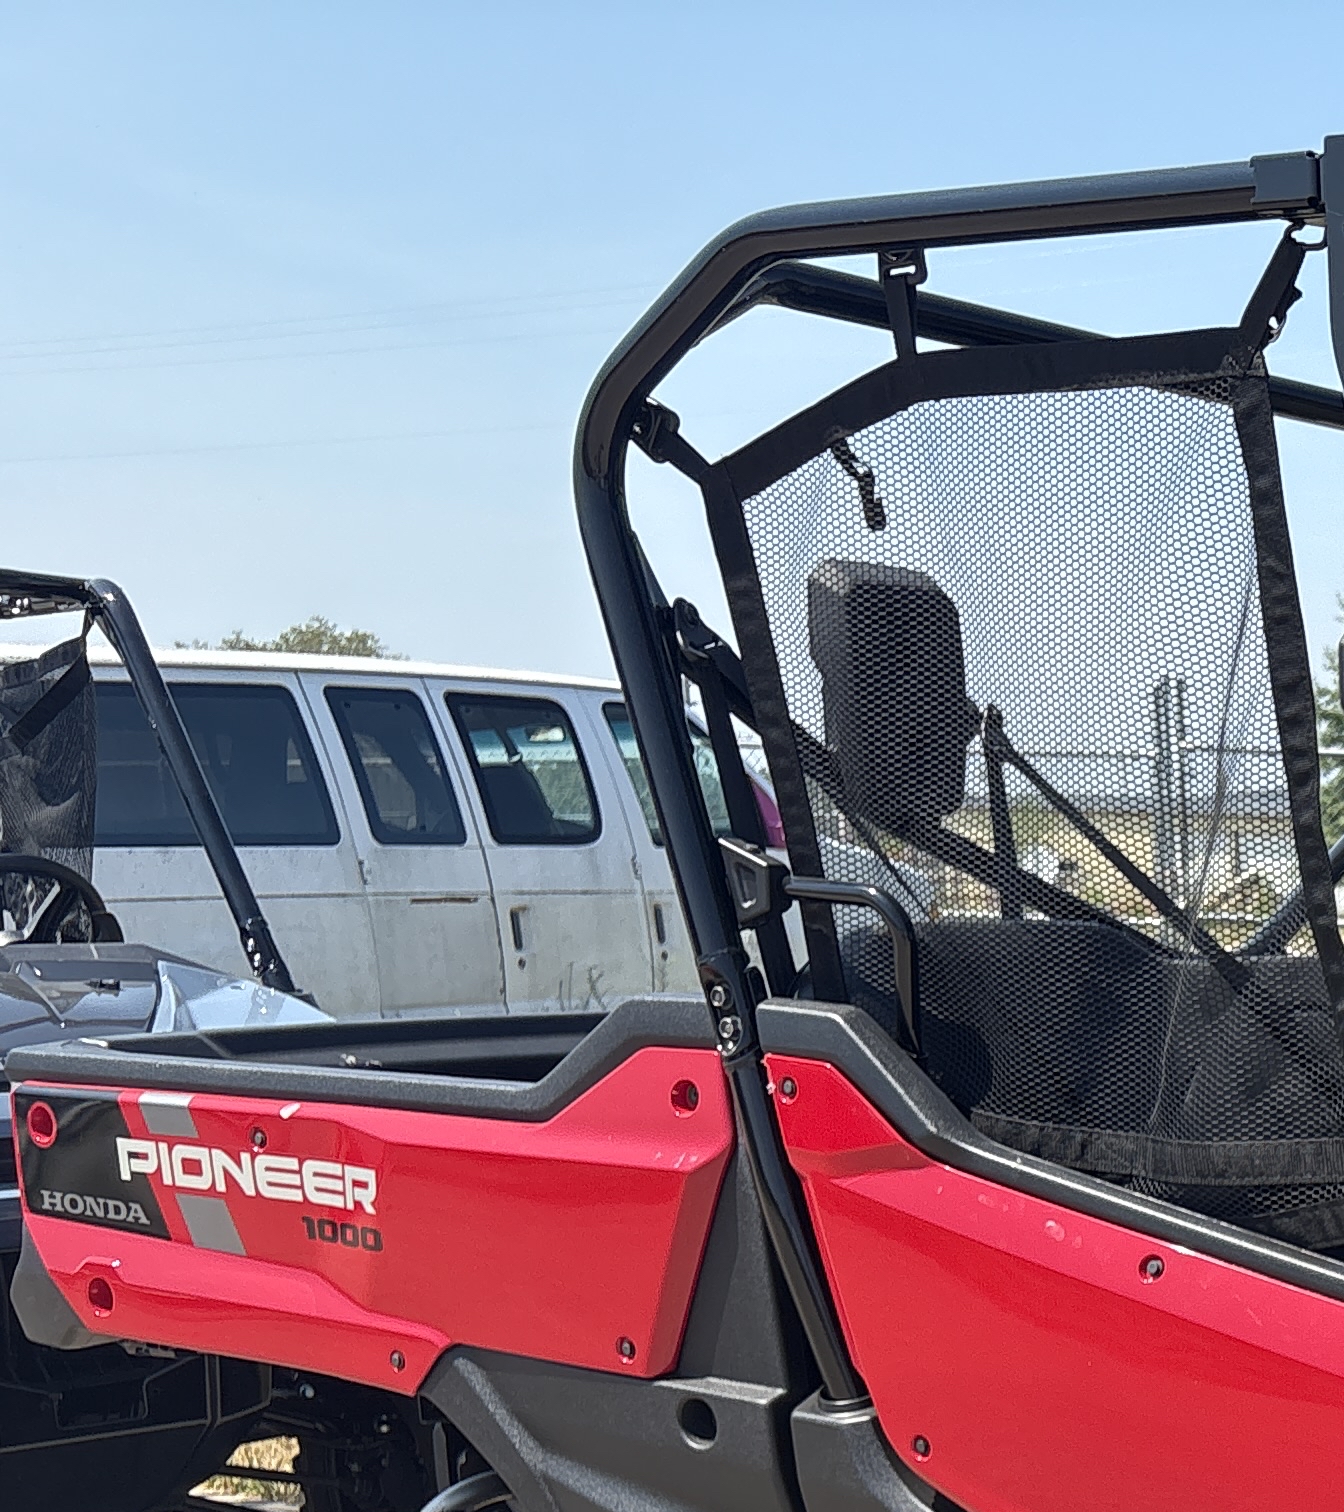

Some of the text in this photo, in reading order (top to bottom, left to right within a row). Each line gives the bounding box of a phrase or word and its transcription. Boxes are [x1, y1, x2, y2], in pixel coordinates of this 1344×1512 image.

[116, 1137, 376, 1215] PIONEER
[40, 1189, 150, 1225] HONDA
[302, 1215, 383, 1252] 1000
